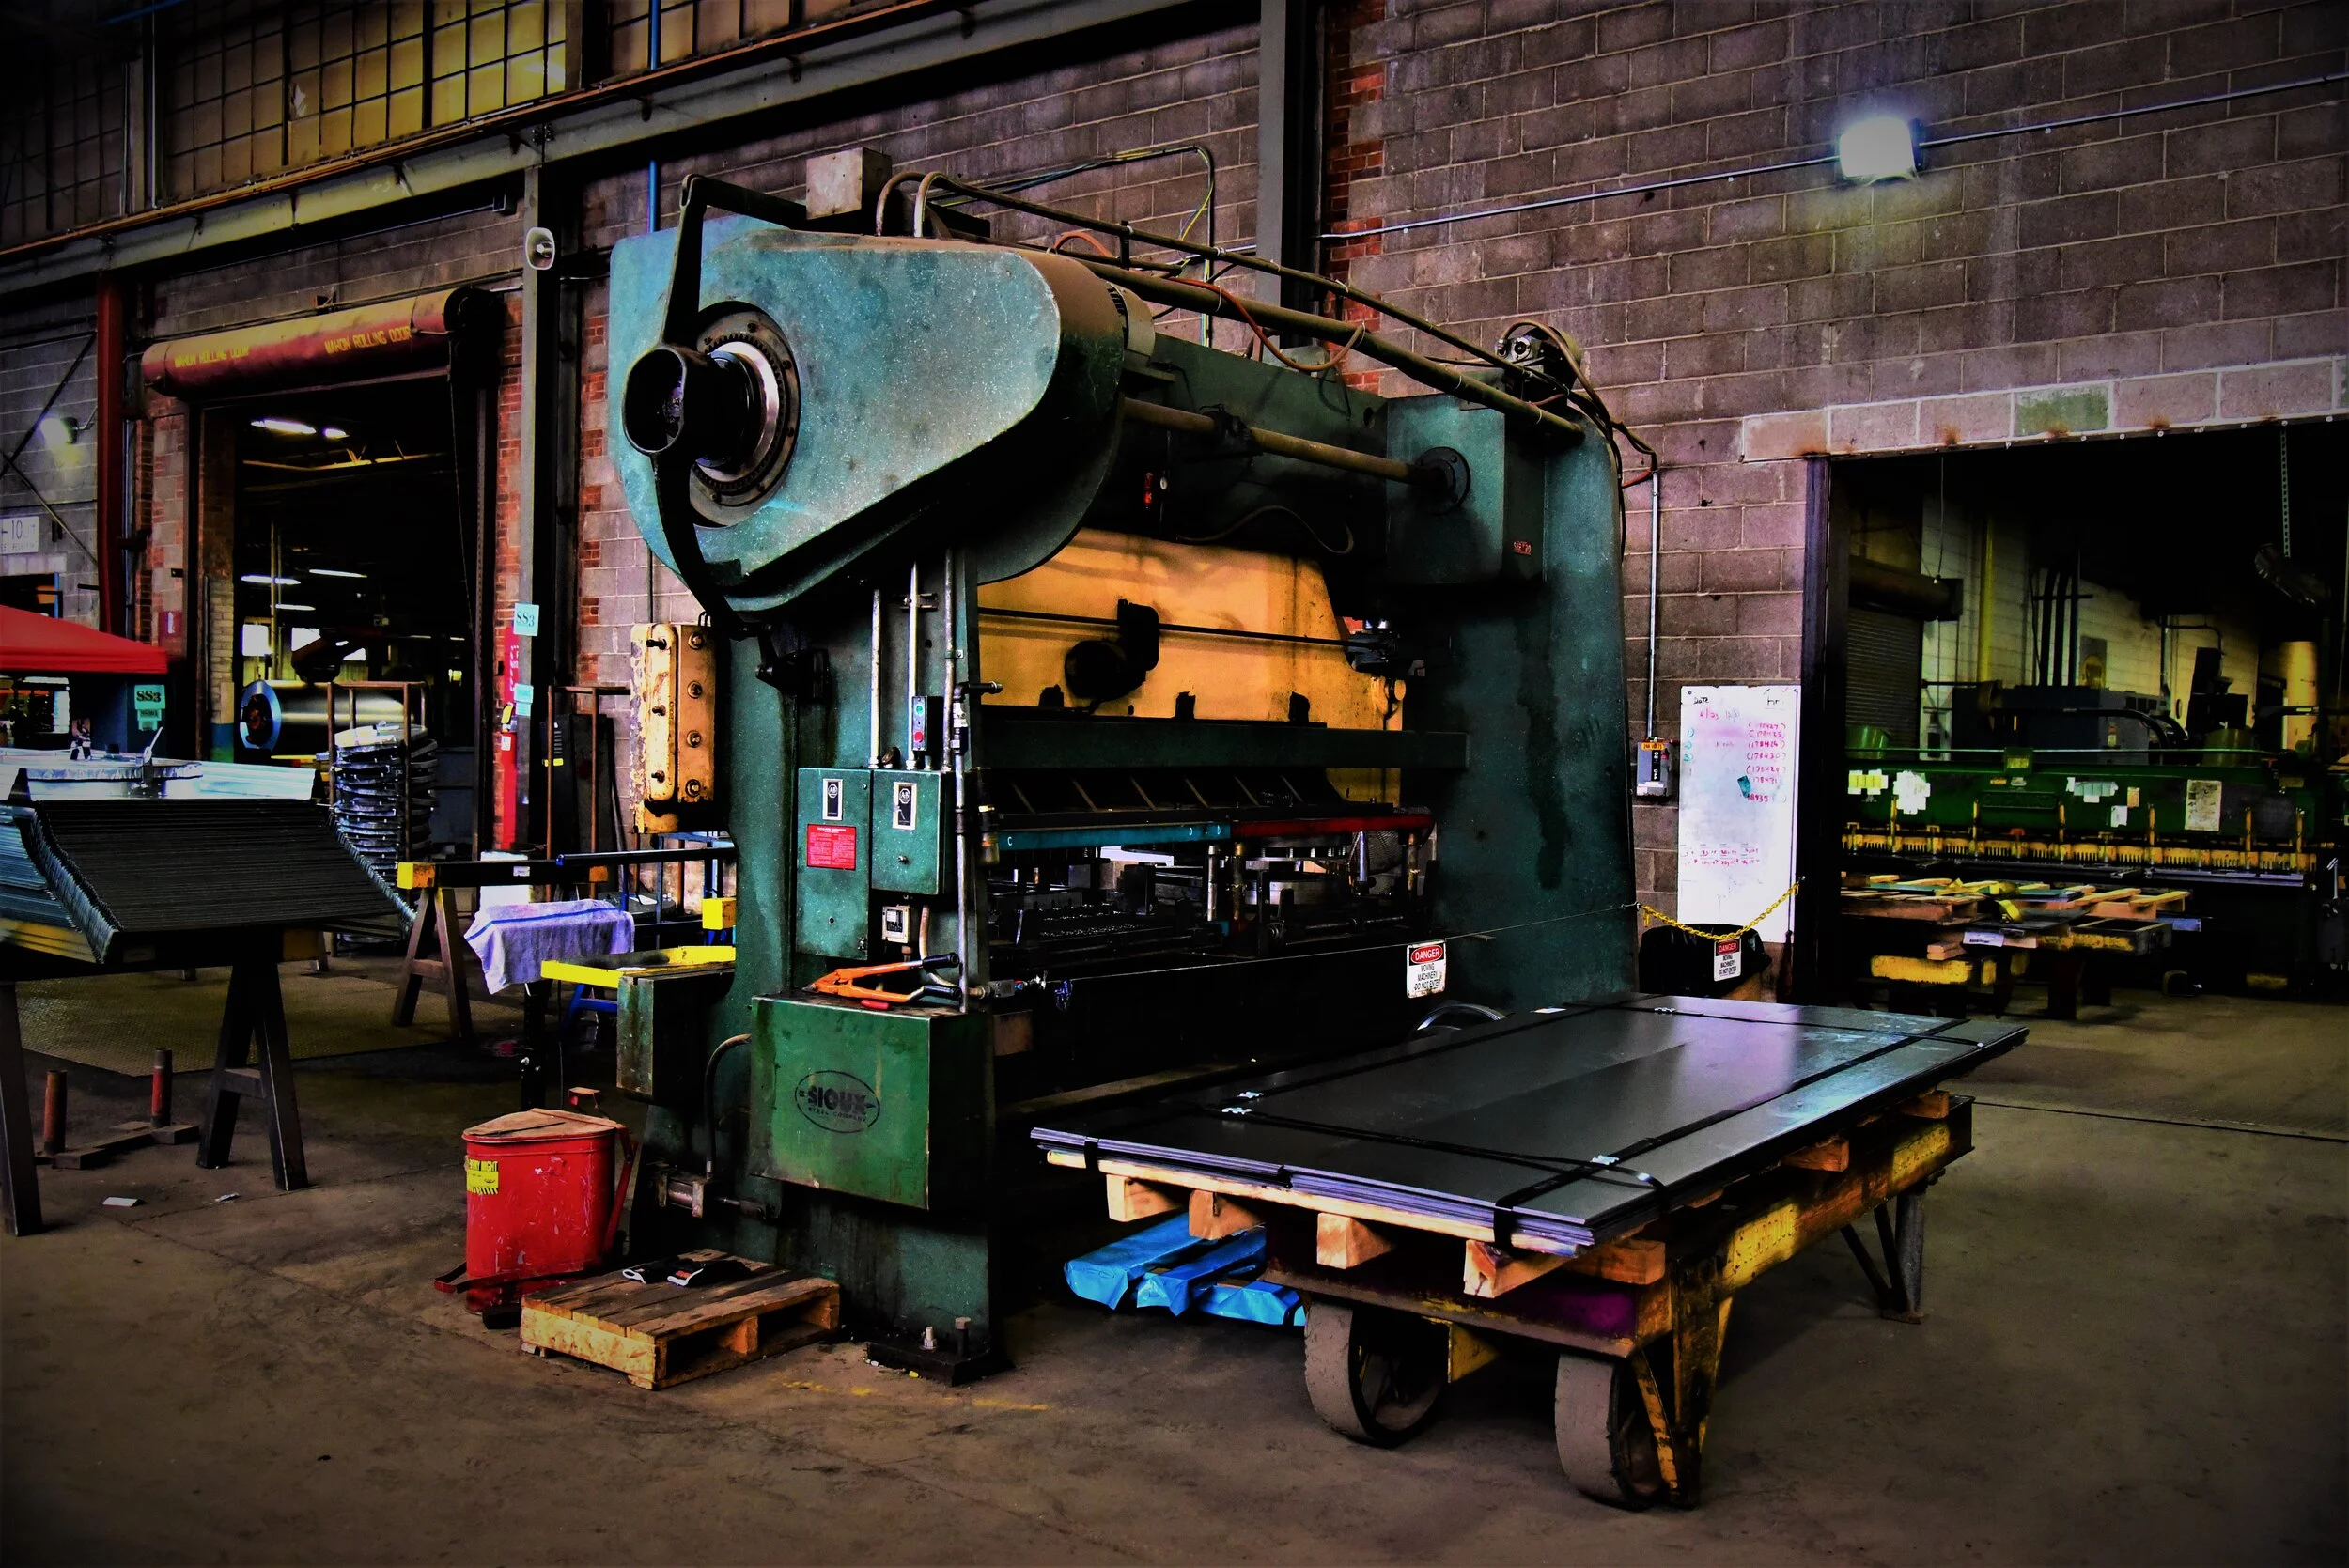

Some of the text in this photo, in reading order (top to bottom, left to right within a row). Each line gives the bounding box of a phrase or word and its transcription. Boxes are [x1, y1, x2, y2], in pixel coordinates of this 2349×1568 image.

[516, 611, 535, 628] SS3
[136, 691, 162, 703] SS3
[1414, 948, 1439, 961] DANGER
[808, 1086, 866, 1112] SIOUX
